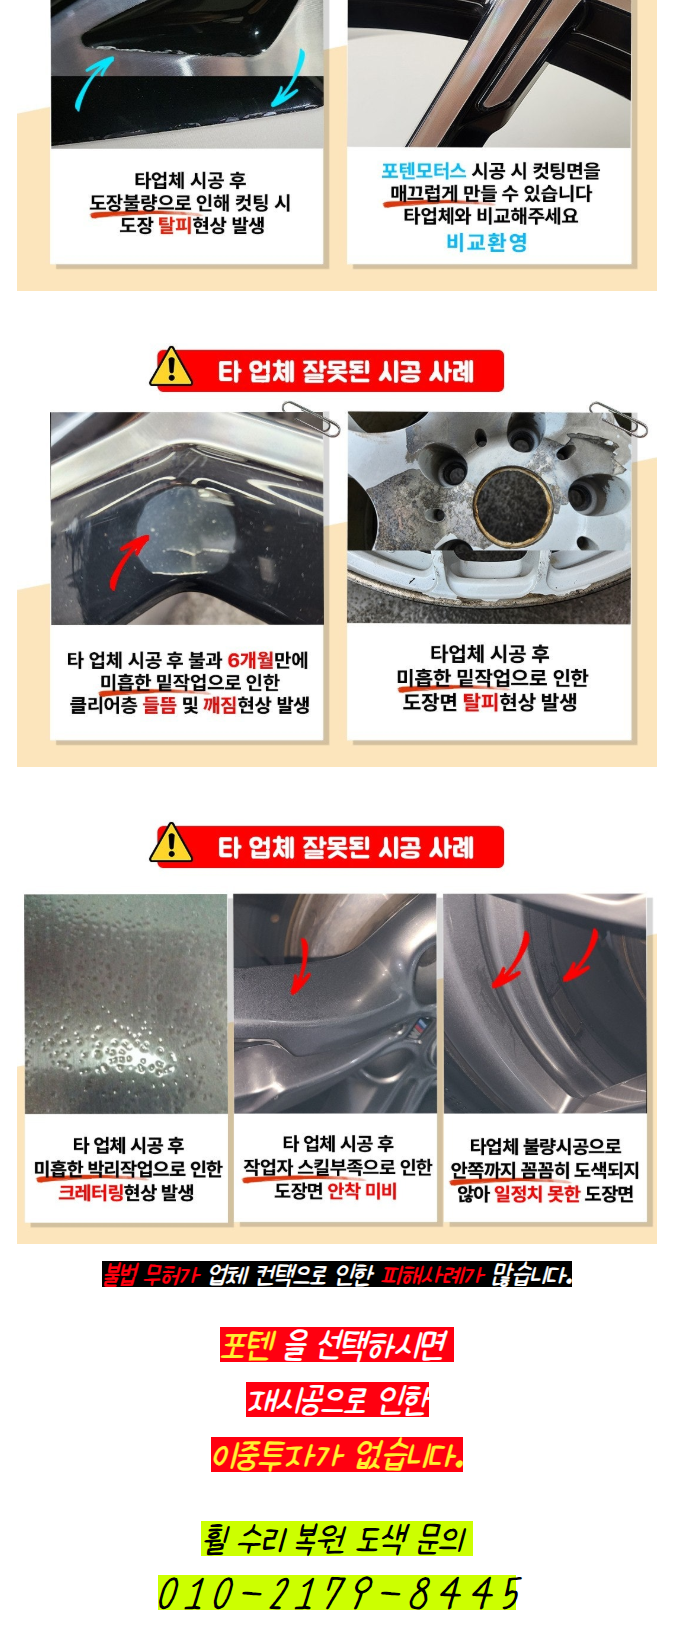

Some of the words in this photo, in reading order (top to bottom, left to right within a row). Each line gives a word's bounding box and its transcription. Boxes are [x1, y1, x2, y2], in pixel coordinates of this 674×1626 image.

[447, 233, 526, 252] 비교환영
[219, 360, 242, 383] 타
[249, 359, 294, 383] 업체
[303, 360, 370, 383] 잘못된
[378, 360, 421, 383] 시공
[429, 360, 473, 383] 사례
[471, 1138, 518, 1155] 타업체
[523, 1138, 621, 1155] 불량시공으로
[59, 1184, 157, 1202] 크레터링현상
[162, 1184, 193, 1202] 발생
